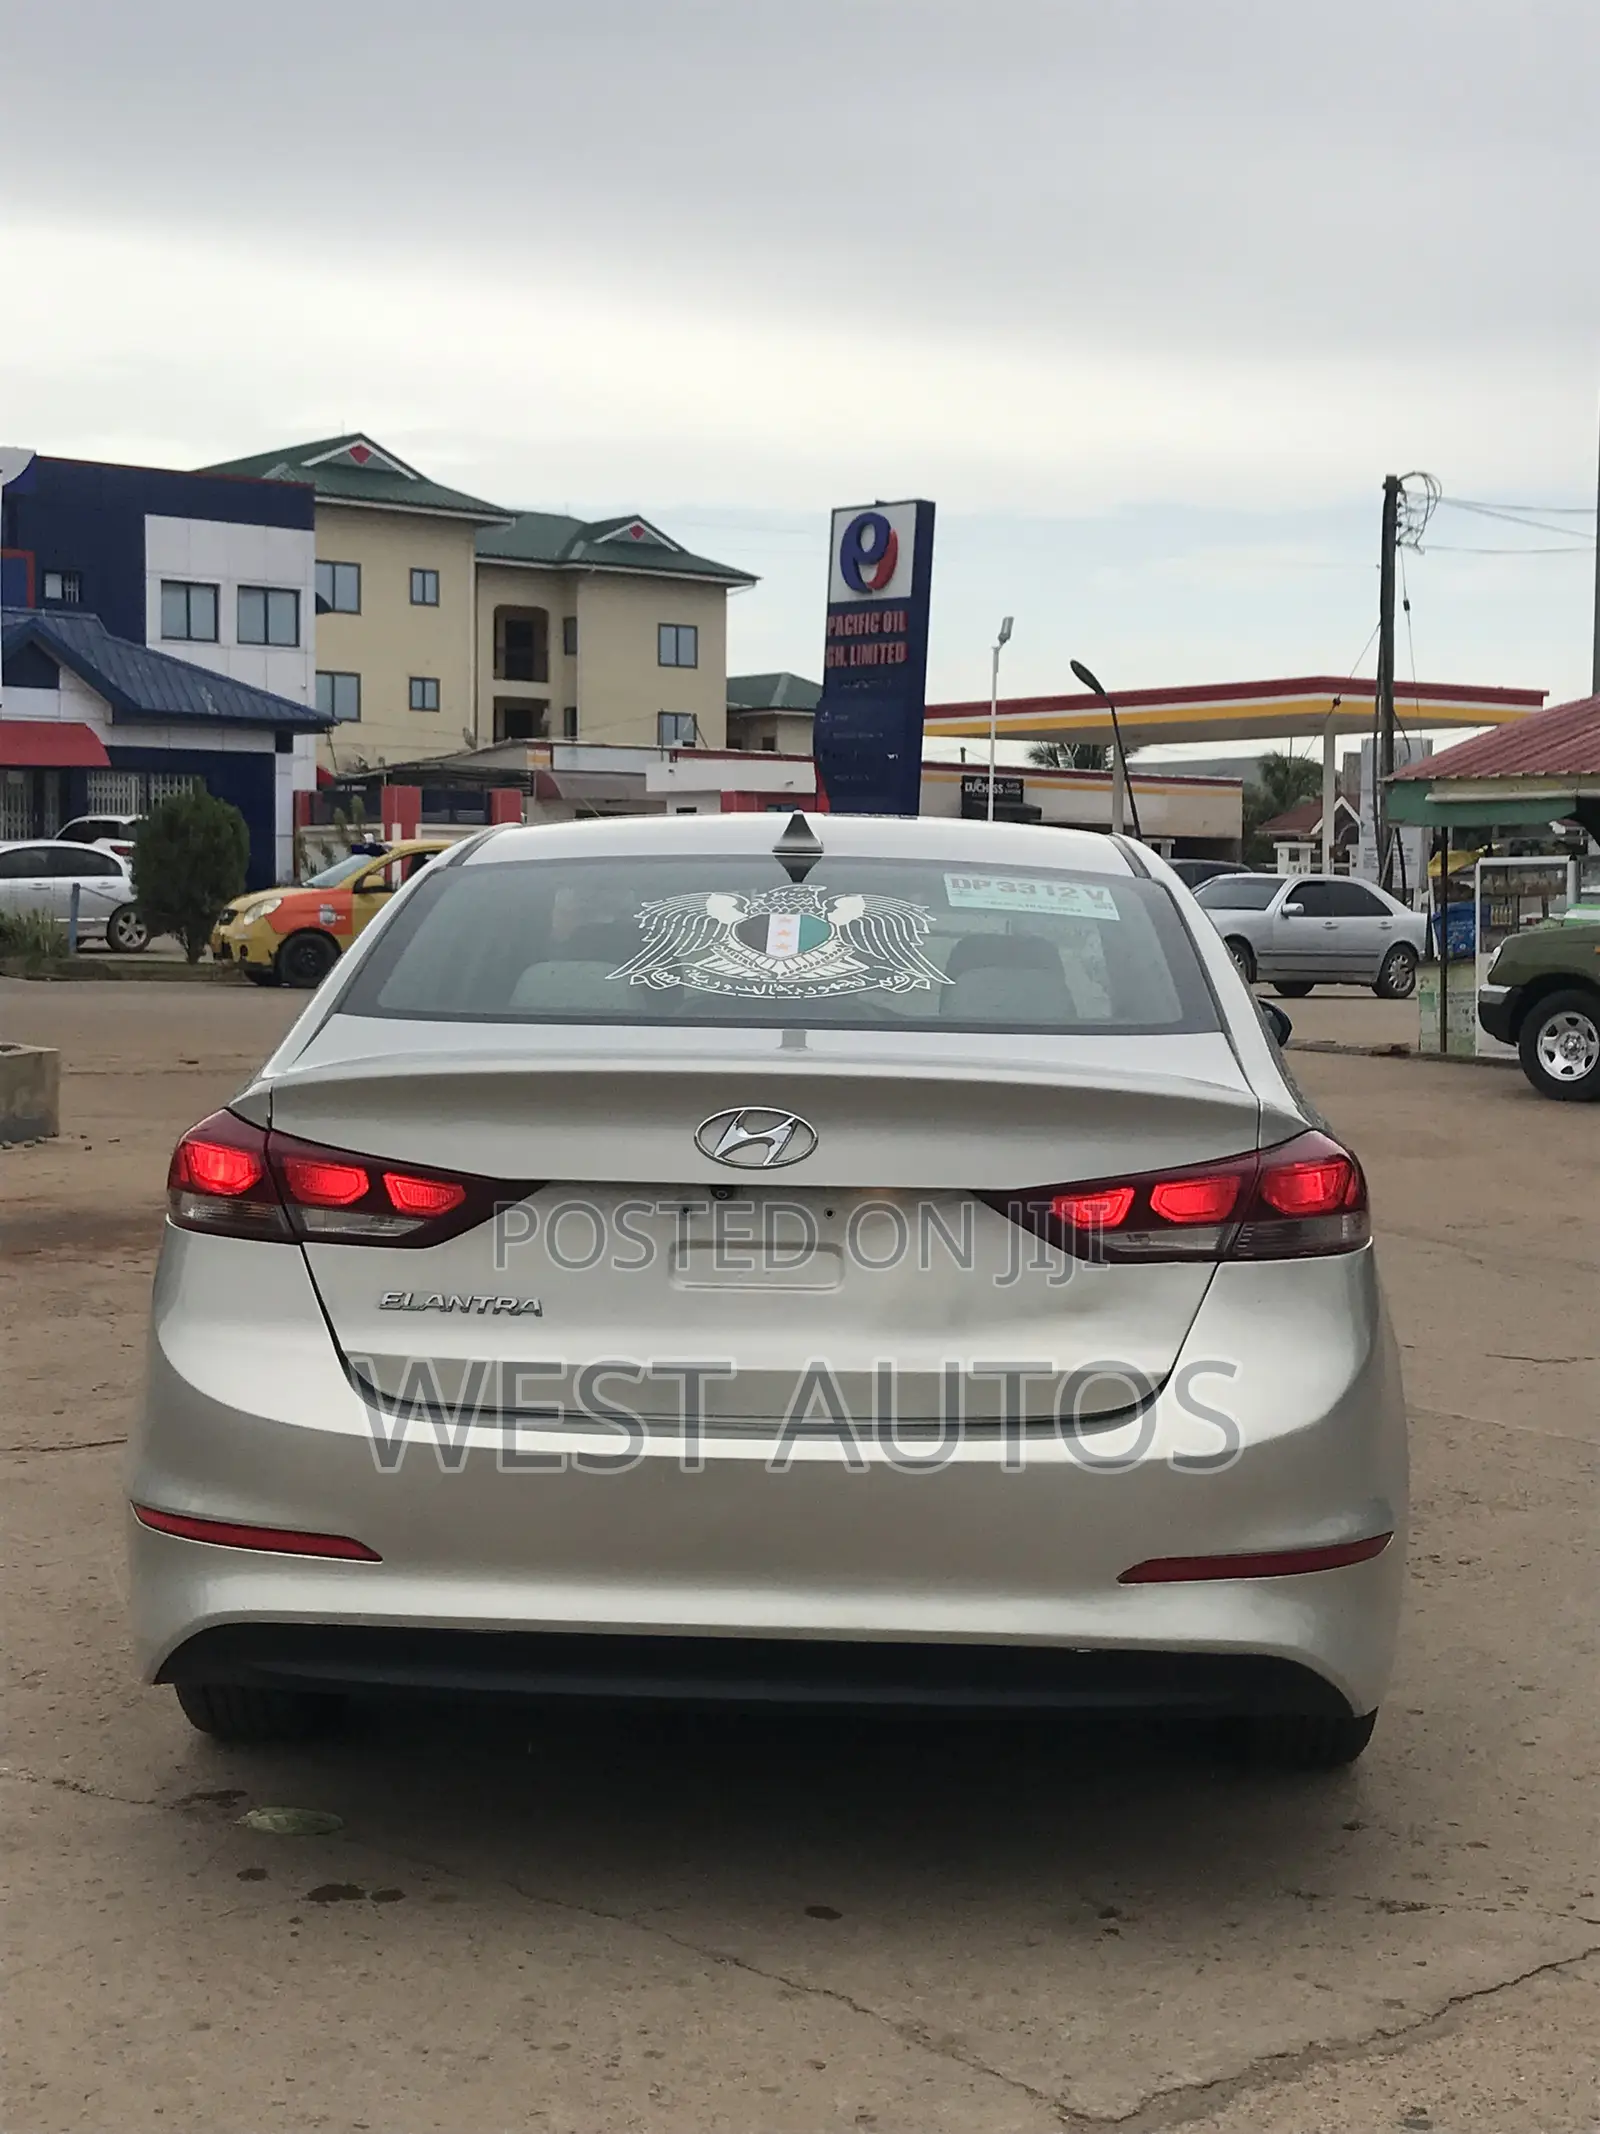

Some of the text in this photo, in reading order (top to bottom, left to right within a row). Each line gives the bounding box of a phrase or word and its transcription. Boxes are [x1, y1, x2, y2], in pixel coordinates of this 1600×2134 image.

[827, 610, 907, 636] PACIFIC OIL
[849, 641, 907, 665] LIMITED
[964, 780, 1003, 794] DUCHSS
[379, 1291, 543, 1317] ELANTRA
